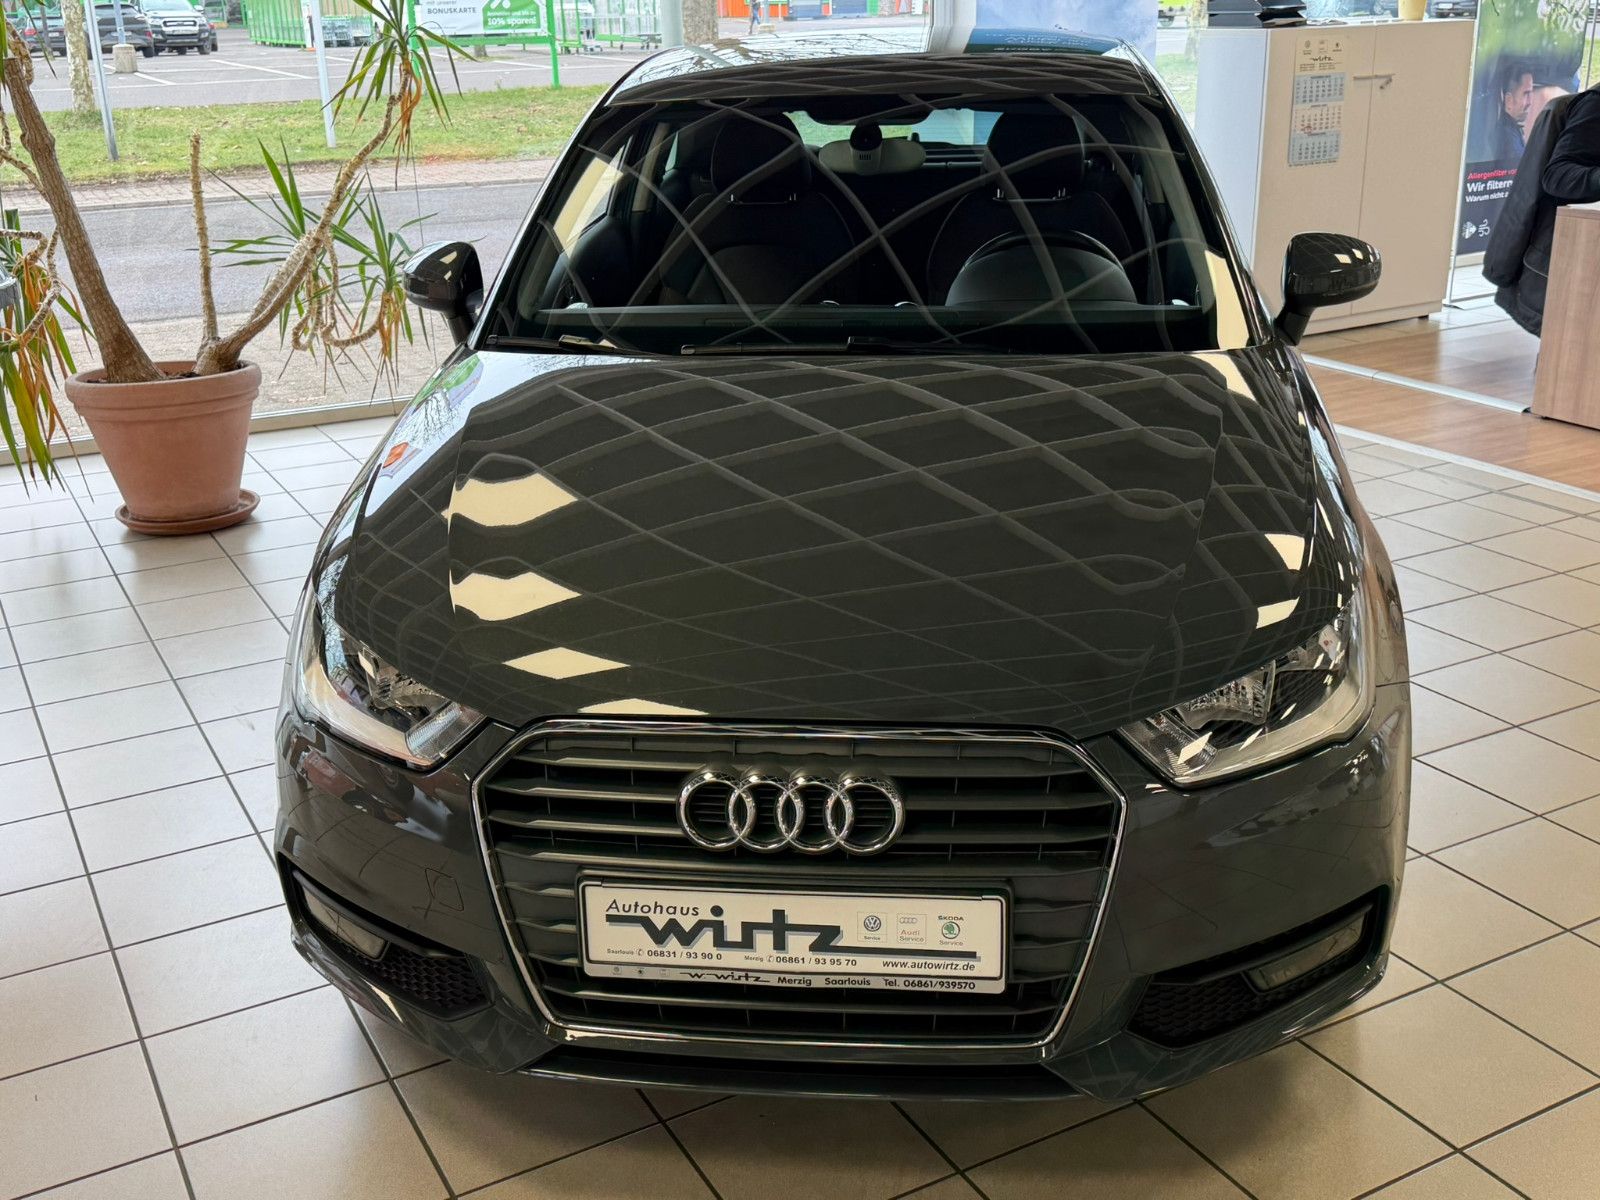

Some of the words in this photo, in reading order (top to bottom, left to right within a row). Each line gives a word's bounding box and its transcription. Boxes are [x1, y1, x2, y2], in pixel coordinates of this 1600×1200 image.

[427, 7, 476, 15] BONUSKARTE
[487, 17, 506, 25] 10%
[507, 16, 537, 26] sparen!
[1467, 181, 1485, 192] Wir
[1465, 194, 1489, 202] Warum
[1490, 192, 1505, 200] nicht
[605, 898, 700, 916] Autohaus
[901, 928, 920, 936] Audi
[899, 935, 924, 943] Service
[939, 939, 964, 947] Service
[607, 948, 634, 956] Saarlouis
[647, 949, 677, 958] 06831
[685, 951, 698, 960] 93
[701, 952, 713, 960] 90
[716, 953, 722, 961] 0
[775, 956, 805, 965] 06861
[814, 958, 827, 966] 93
[829, 958, 842, 966] 95
[844, 959, 857, 967] 70
[882, 960, 976, 972] www.autowirtz.de
[777, 976, 812, 987] Merzig
[824, 977, 871, 987] Saarlouis
[883, 978, 900, 988] Tel.
[903, 980, 976, 991] 06861/939570
